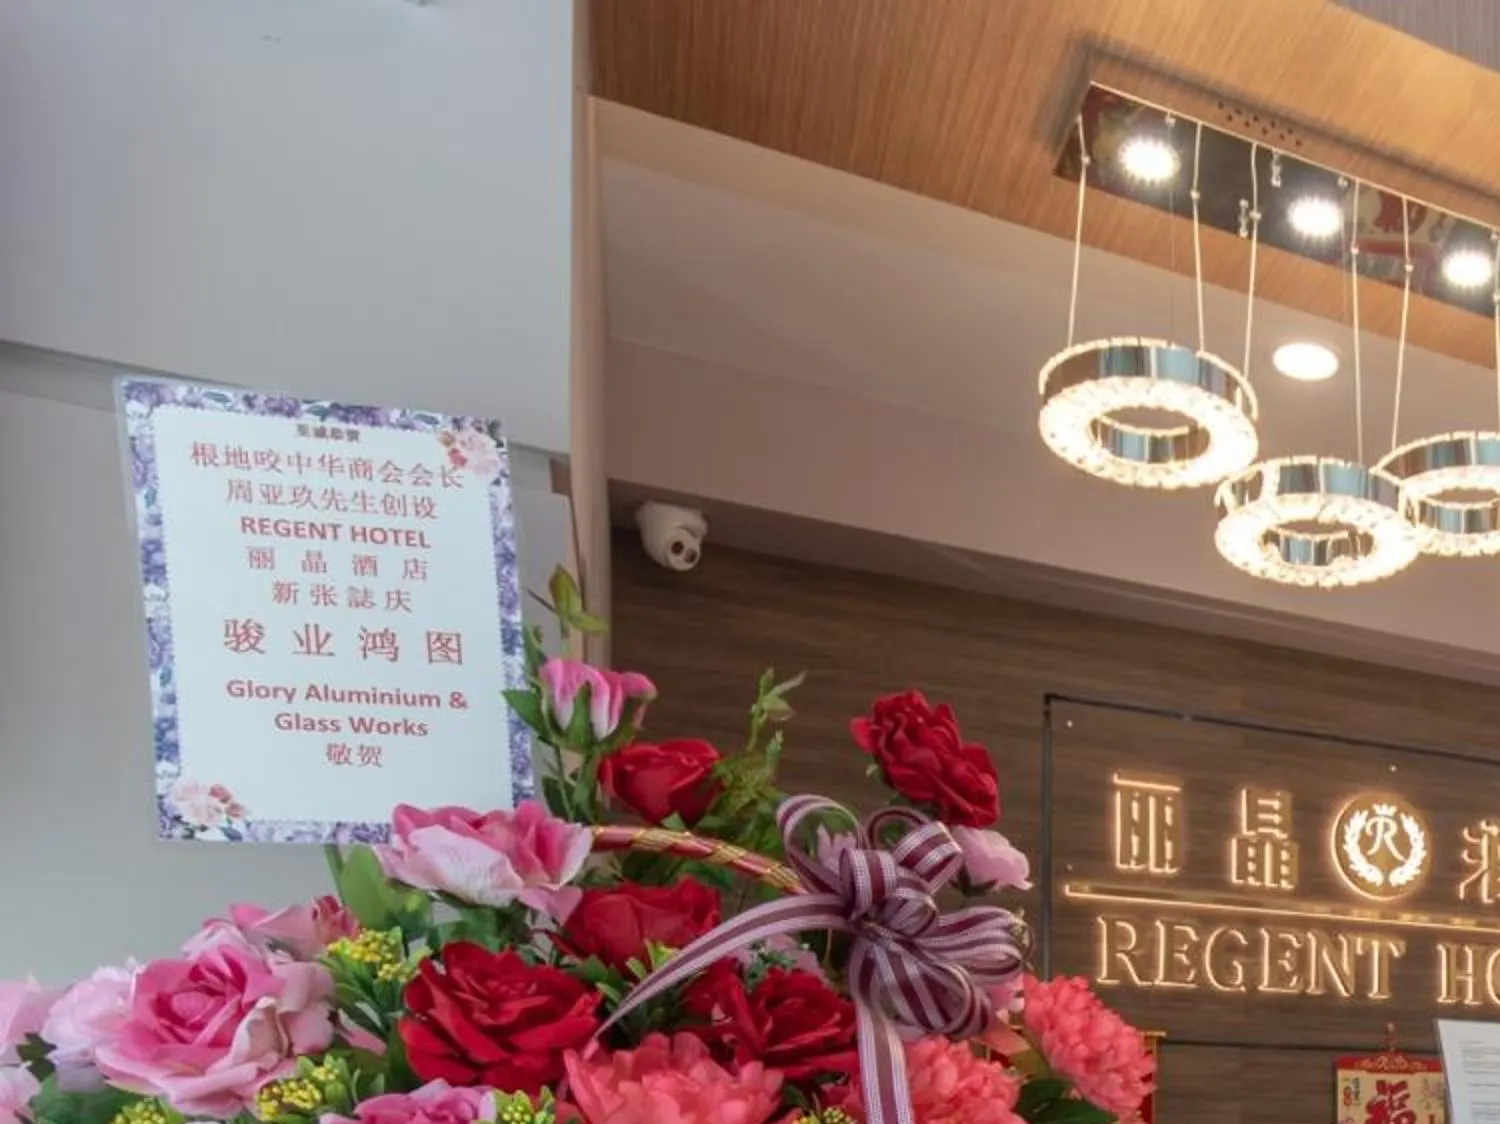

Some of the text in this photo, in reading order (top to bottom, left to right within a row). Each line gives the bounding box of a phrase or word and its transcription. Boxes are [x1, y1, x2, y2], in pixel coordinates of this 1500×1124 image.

[190, 440, 465, 490] 根地咬中华商会会长
[240, 515, 431, 549] REGENT HOTEL
[225, 679, 468, 710] Glory Aluminium &
[274, 711, 429, 738] Glass Works
[325, 742, 384, 769] 敬贺
[1364, 814, 1406, 857] R
[1096, 913, 1407, 1000] REGENT
